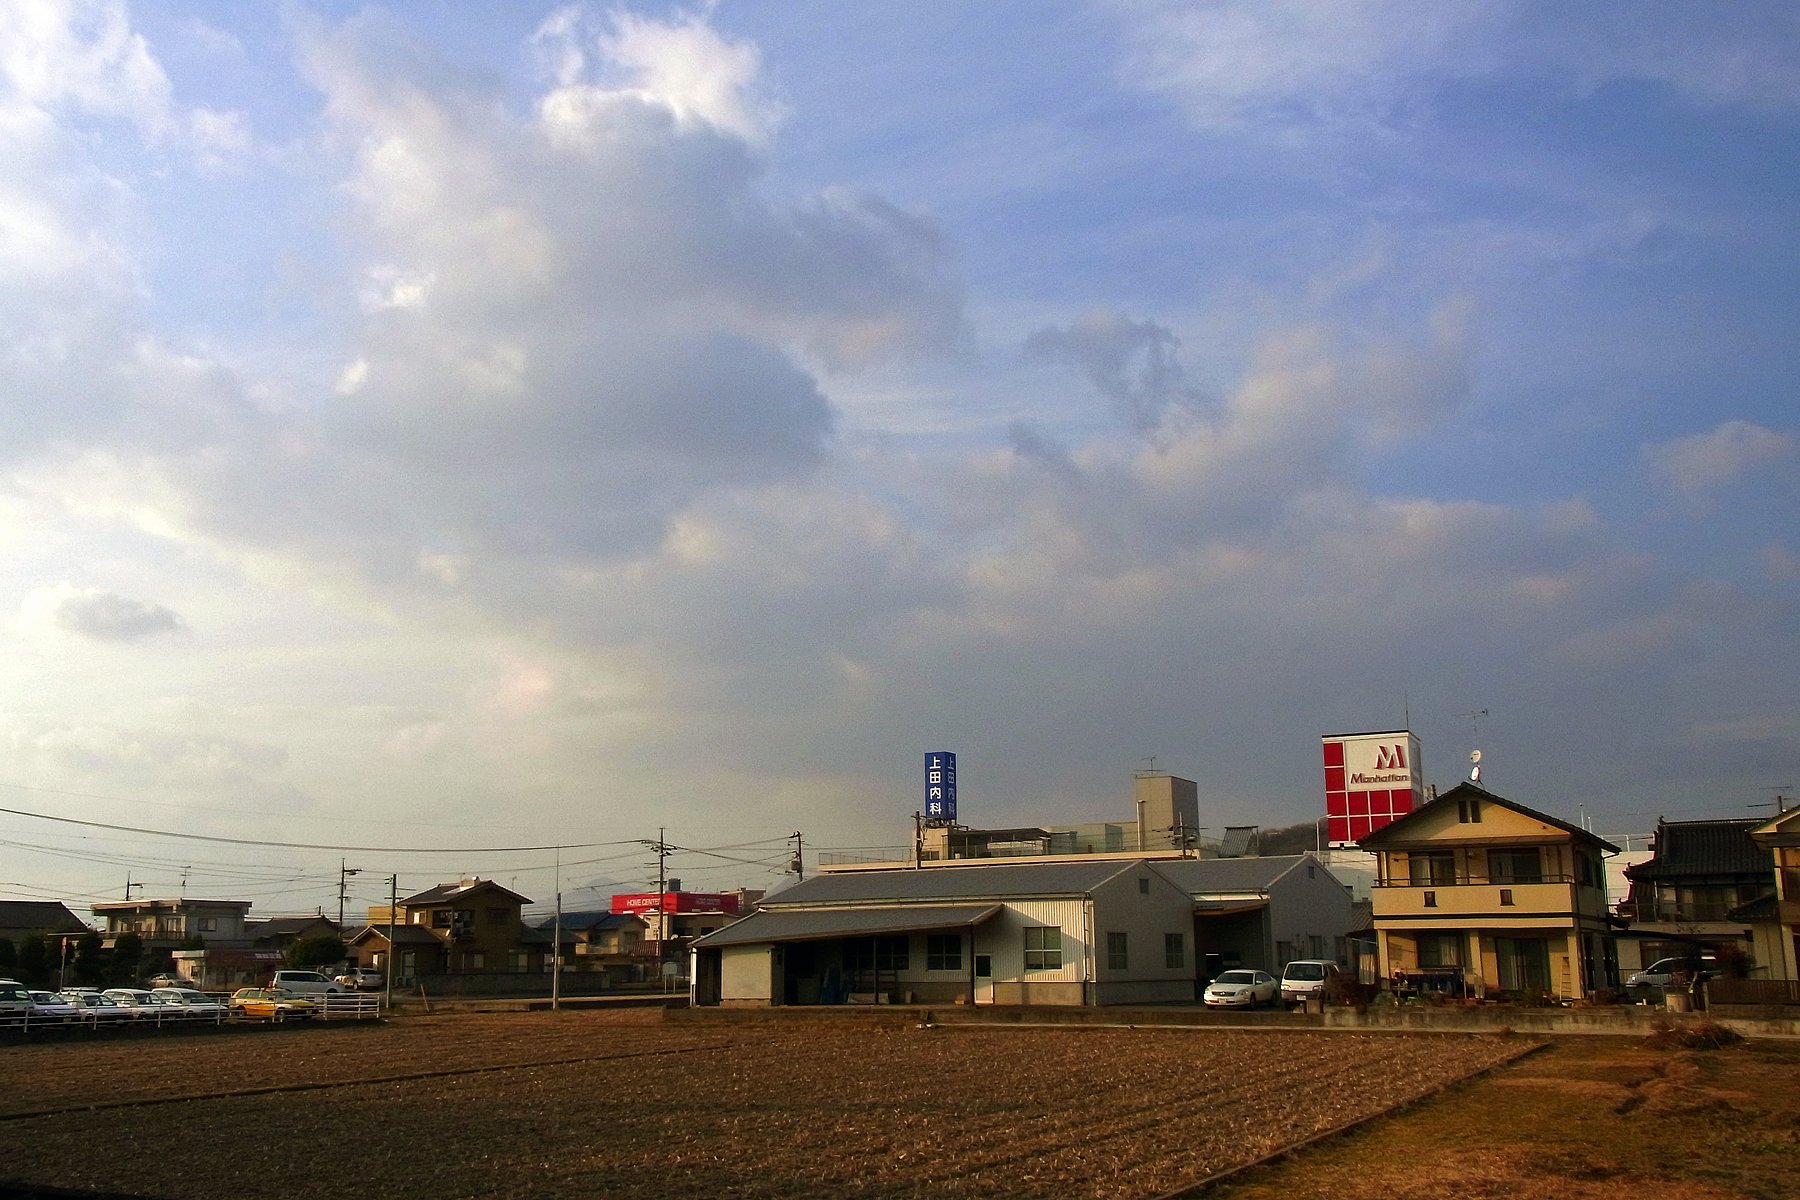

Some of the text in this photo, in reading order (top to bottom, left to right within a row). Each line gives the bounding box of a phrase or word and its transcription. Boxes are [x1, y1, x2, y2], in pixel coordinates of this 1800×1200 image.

[1350, 772, 1409, 784] Manhattan
[929, 756, 942, 815] 上田内科
[627, 898, 641, 907] HOME
